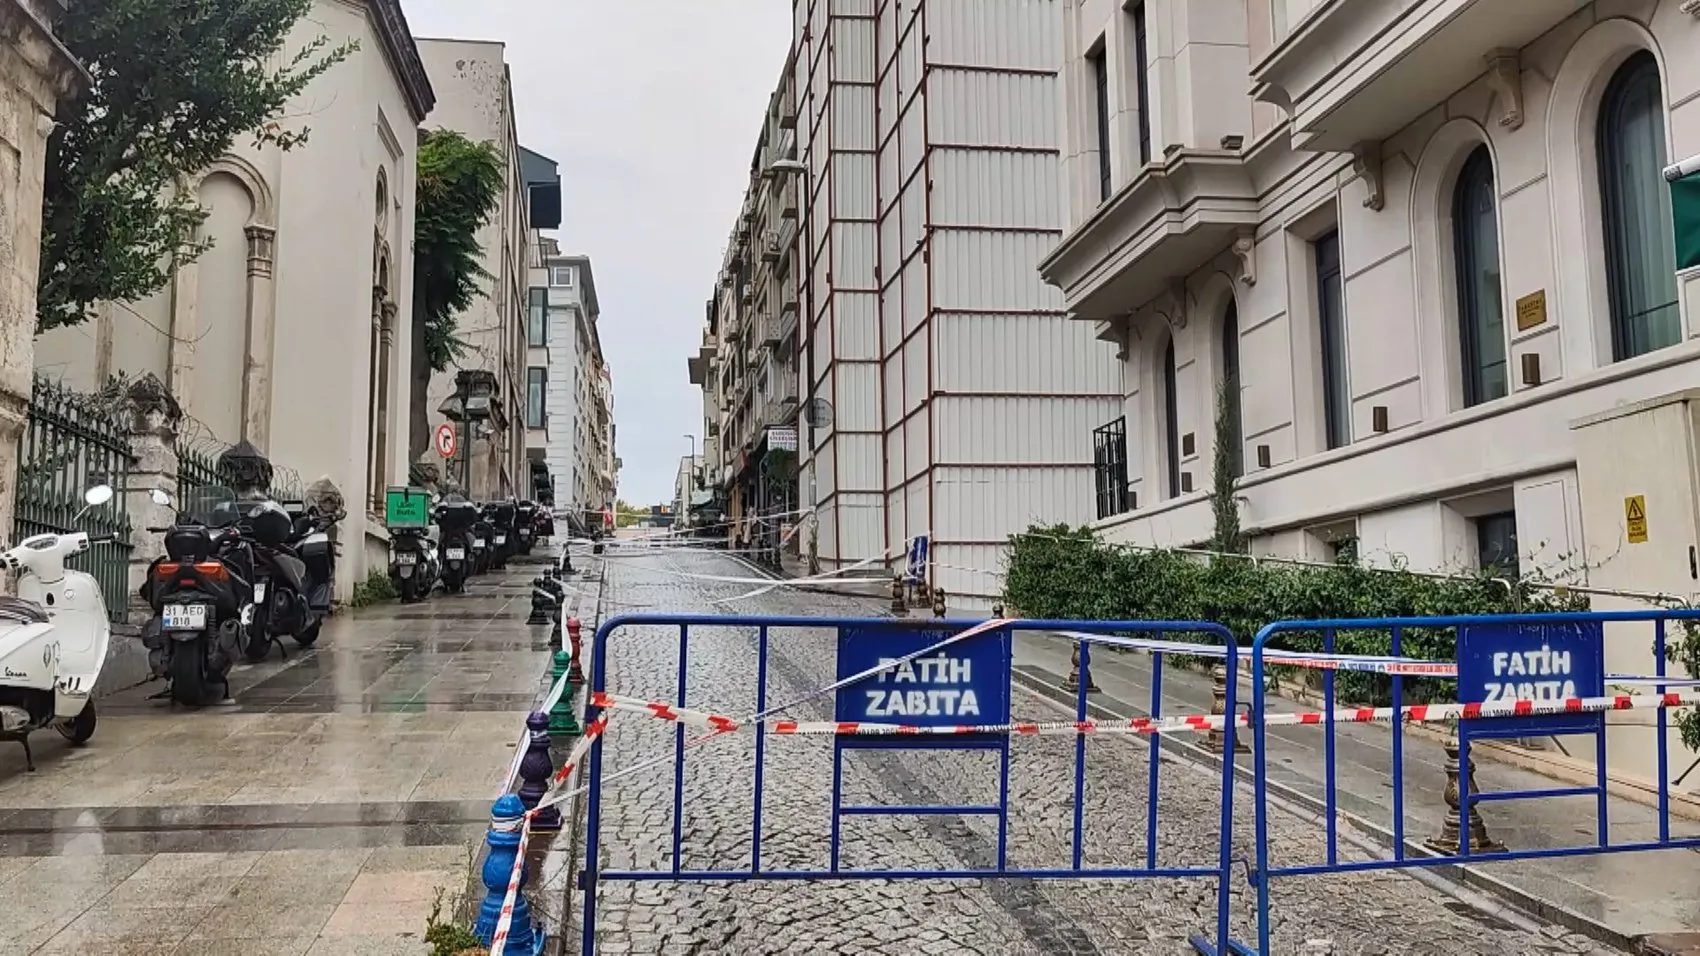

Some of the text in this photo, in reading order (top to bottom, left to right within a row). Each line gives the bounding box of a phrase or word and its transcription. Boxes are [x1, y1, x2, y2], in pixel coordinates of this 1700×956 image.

[878, 651, 971, 684] FATİH
[1493, 644, 1571, 677] FATİH
[865, 689, 980, 717] ZABITA
[1484, 680, 1577, 703] ZABITA
